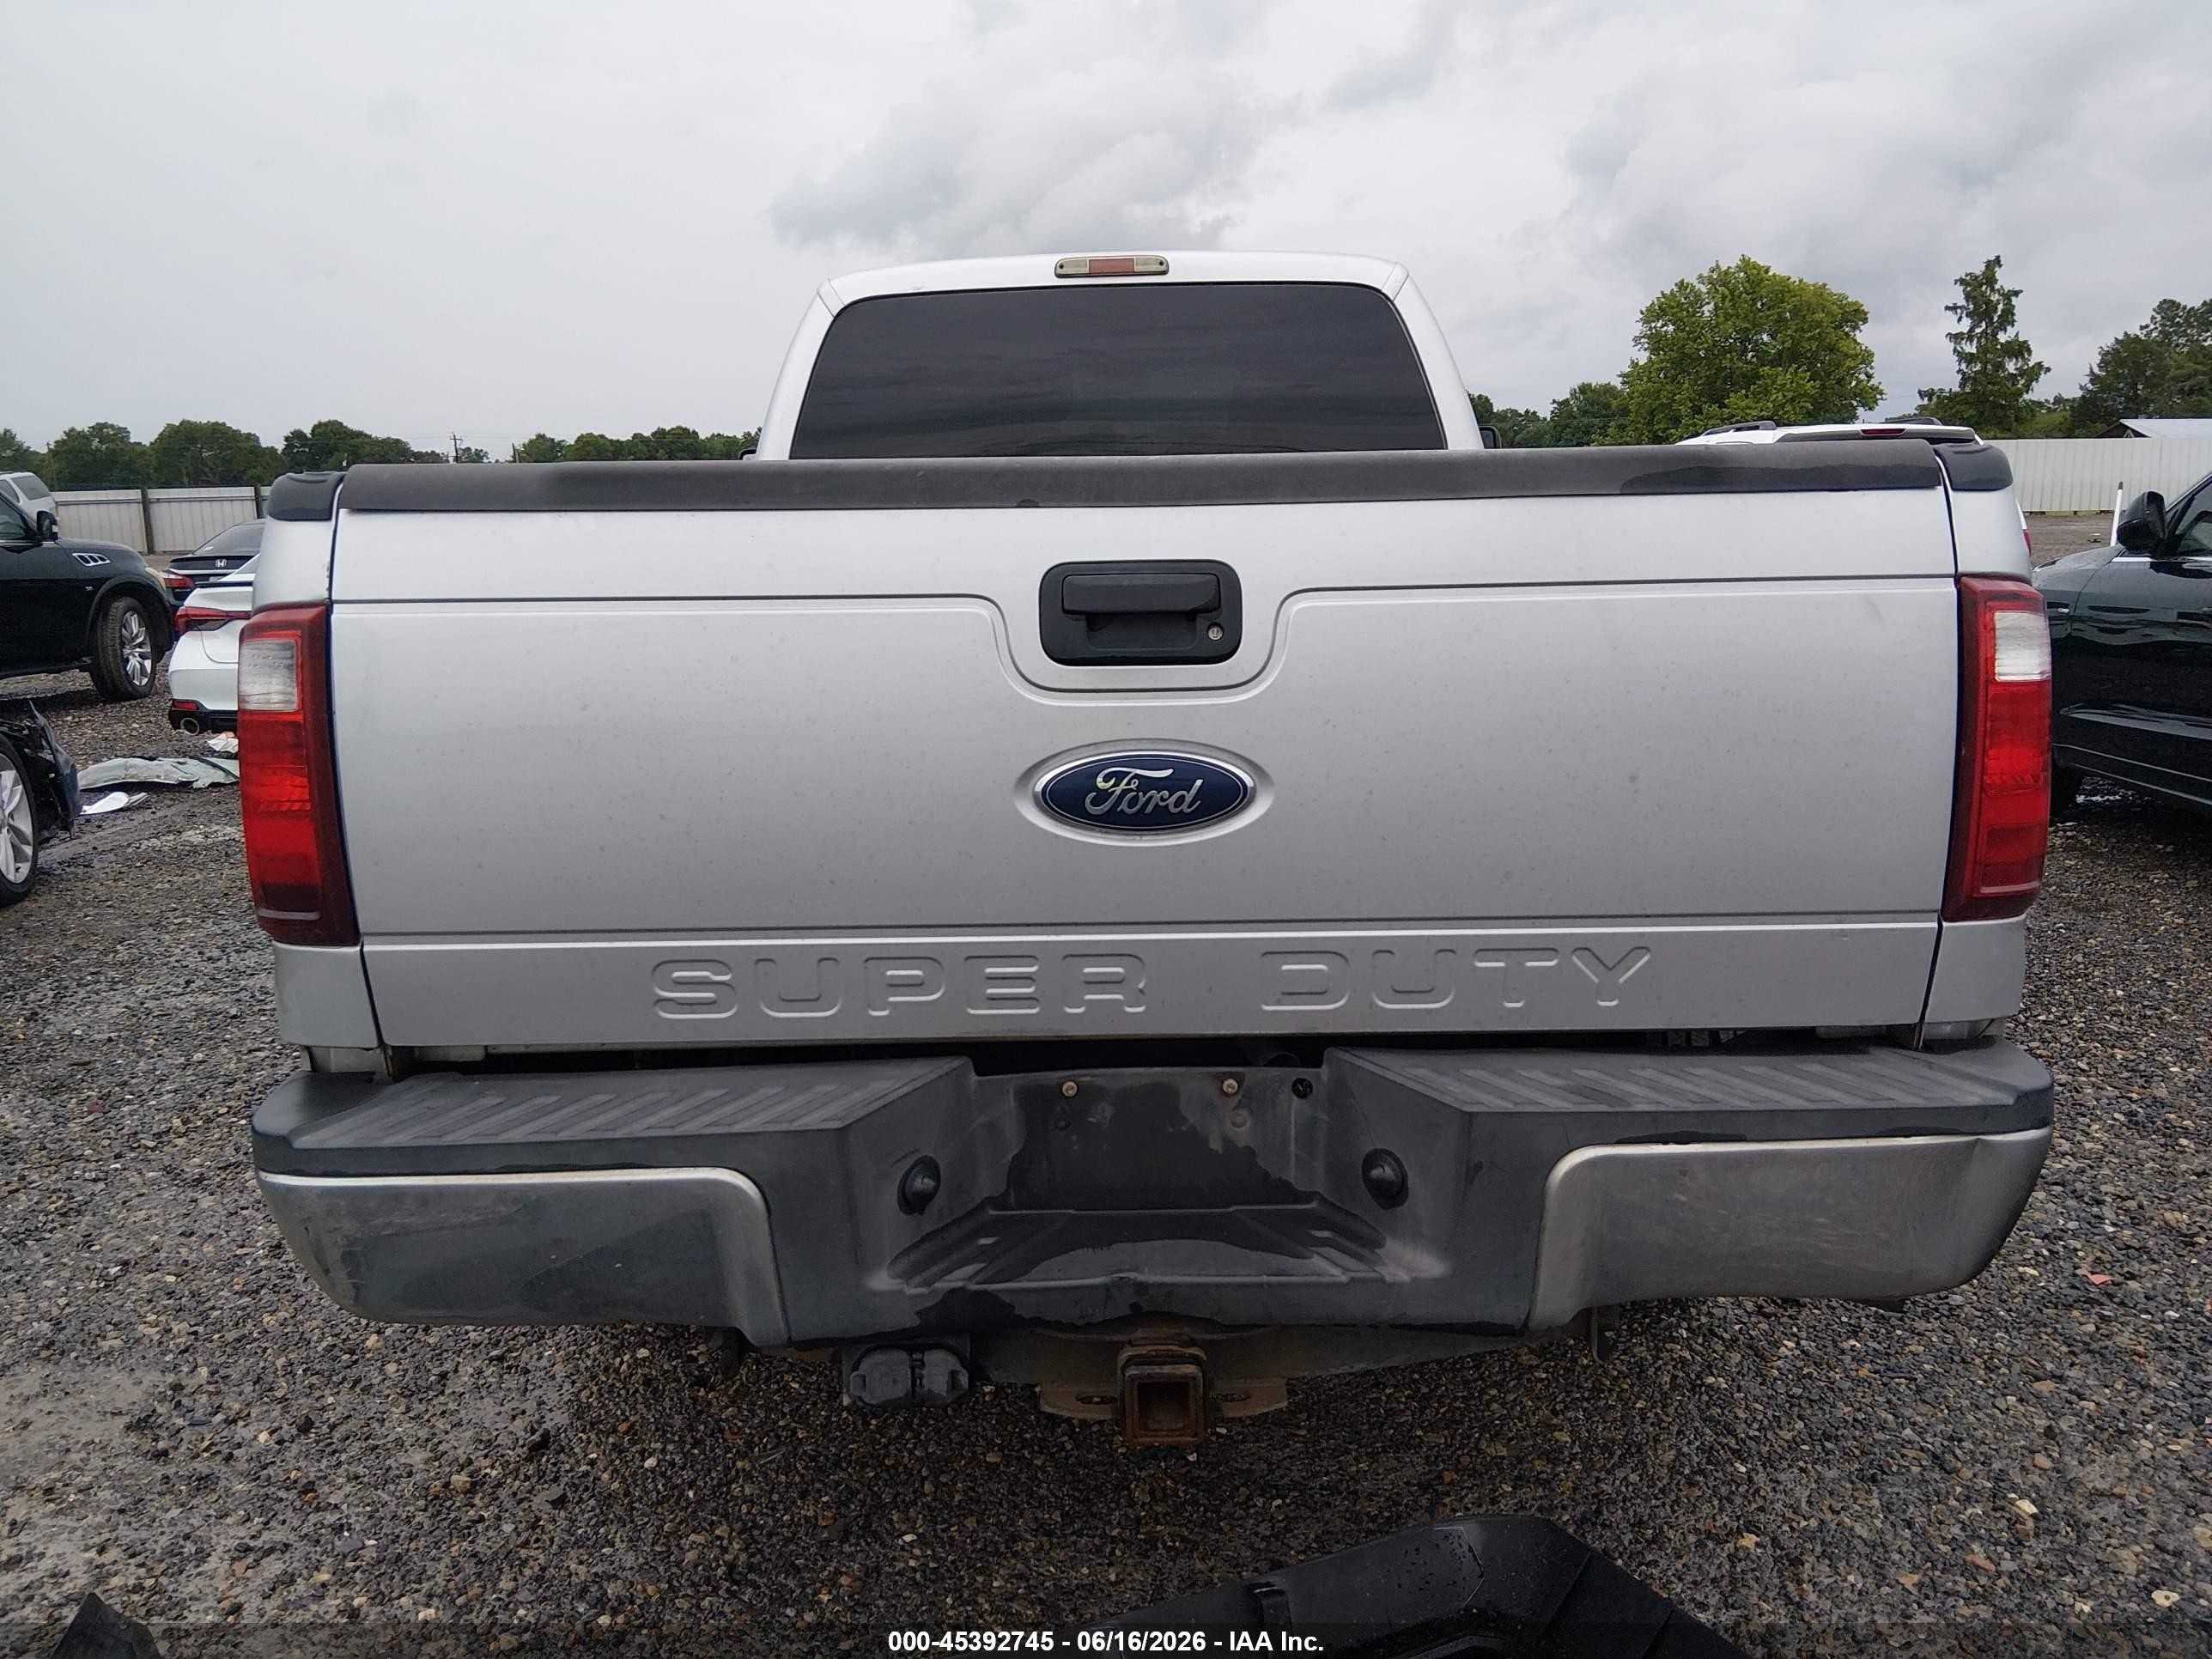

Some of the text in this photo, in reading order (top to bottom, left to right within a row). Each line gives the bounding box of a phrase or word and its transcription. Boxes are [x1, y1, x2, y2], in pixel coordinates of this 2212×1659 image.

[1085, 767, 1204, 815] Ford
[651, 947, 1651, 1018] SUPER DUTY
